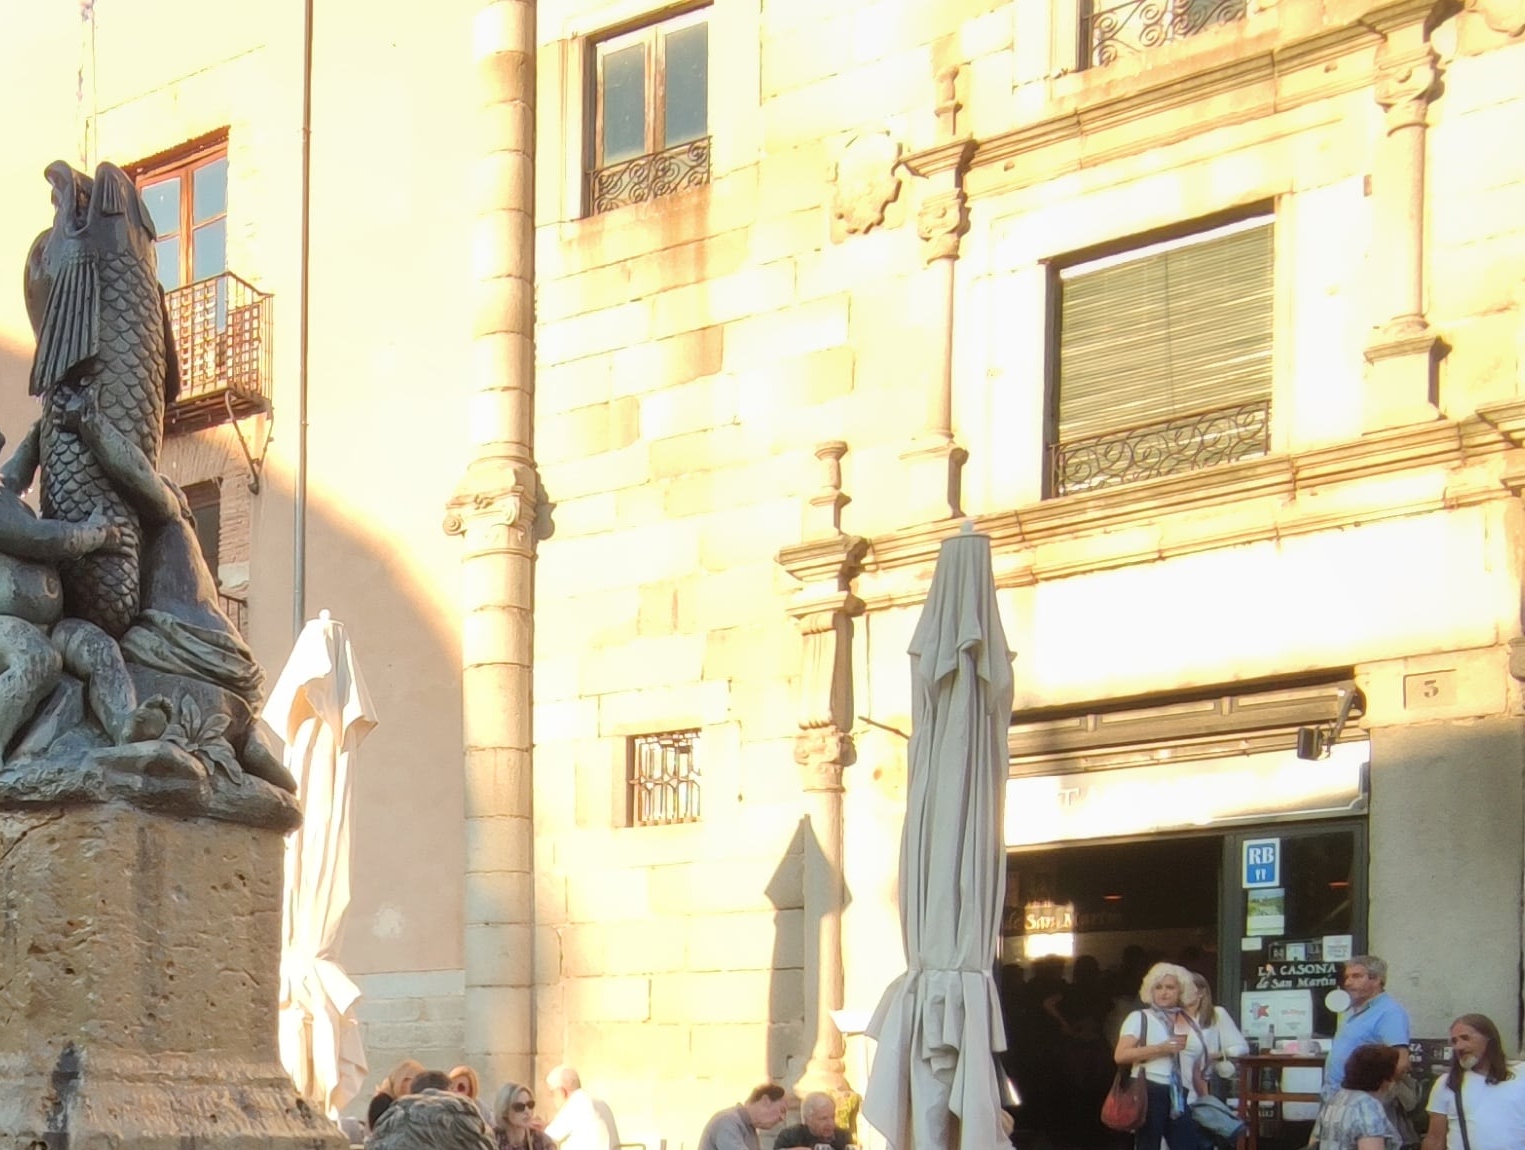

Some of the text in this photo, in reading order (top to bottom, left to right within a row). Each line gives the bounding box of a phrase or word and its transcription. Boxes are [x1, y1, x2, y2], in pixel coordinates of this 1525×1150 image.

[1248, 846, 1275, 865] RB
[1257, 963, 1337, 977] LA CASONA
[1271, 979, 1293, 989] San
[1296, 974, 1337, 987] Martín
